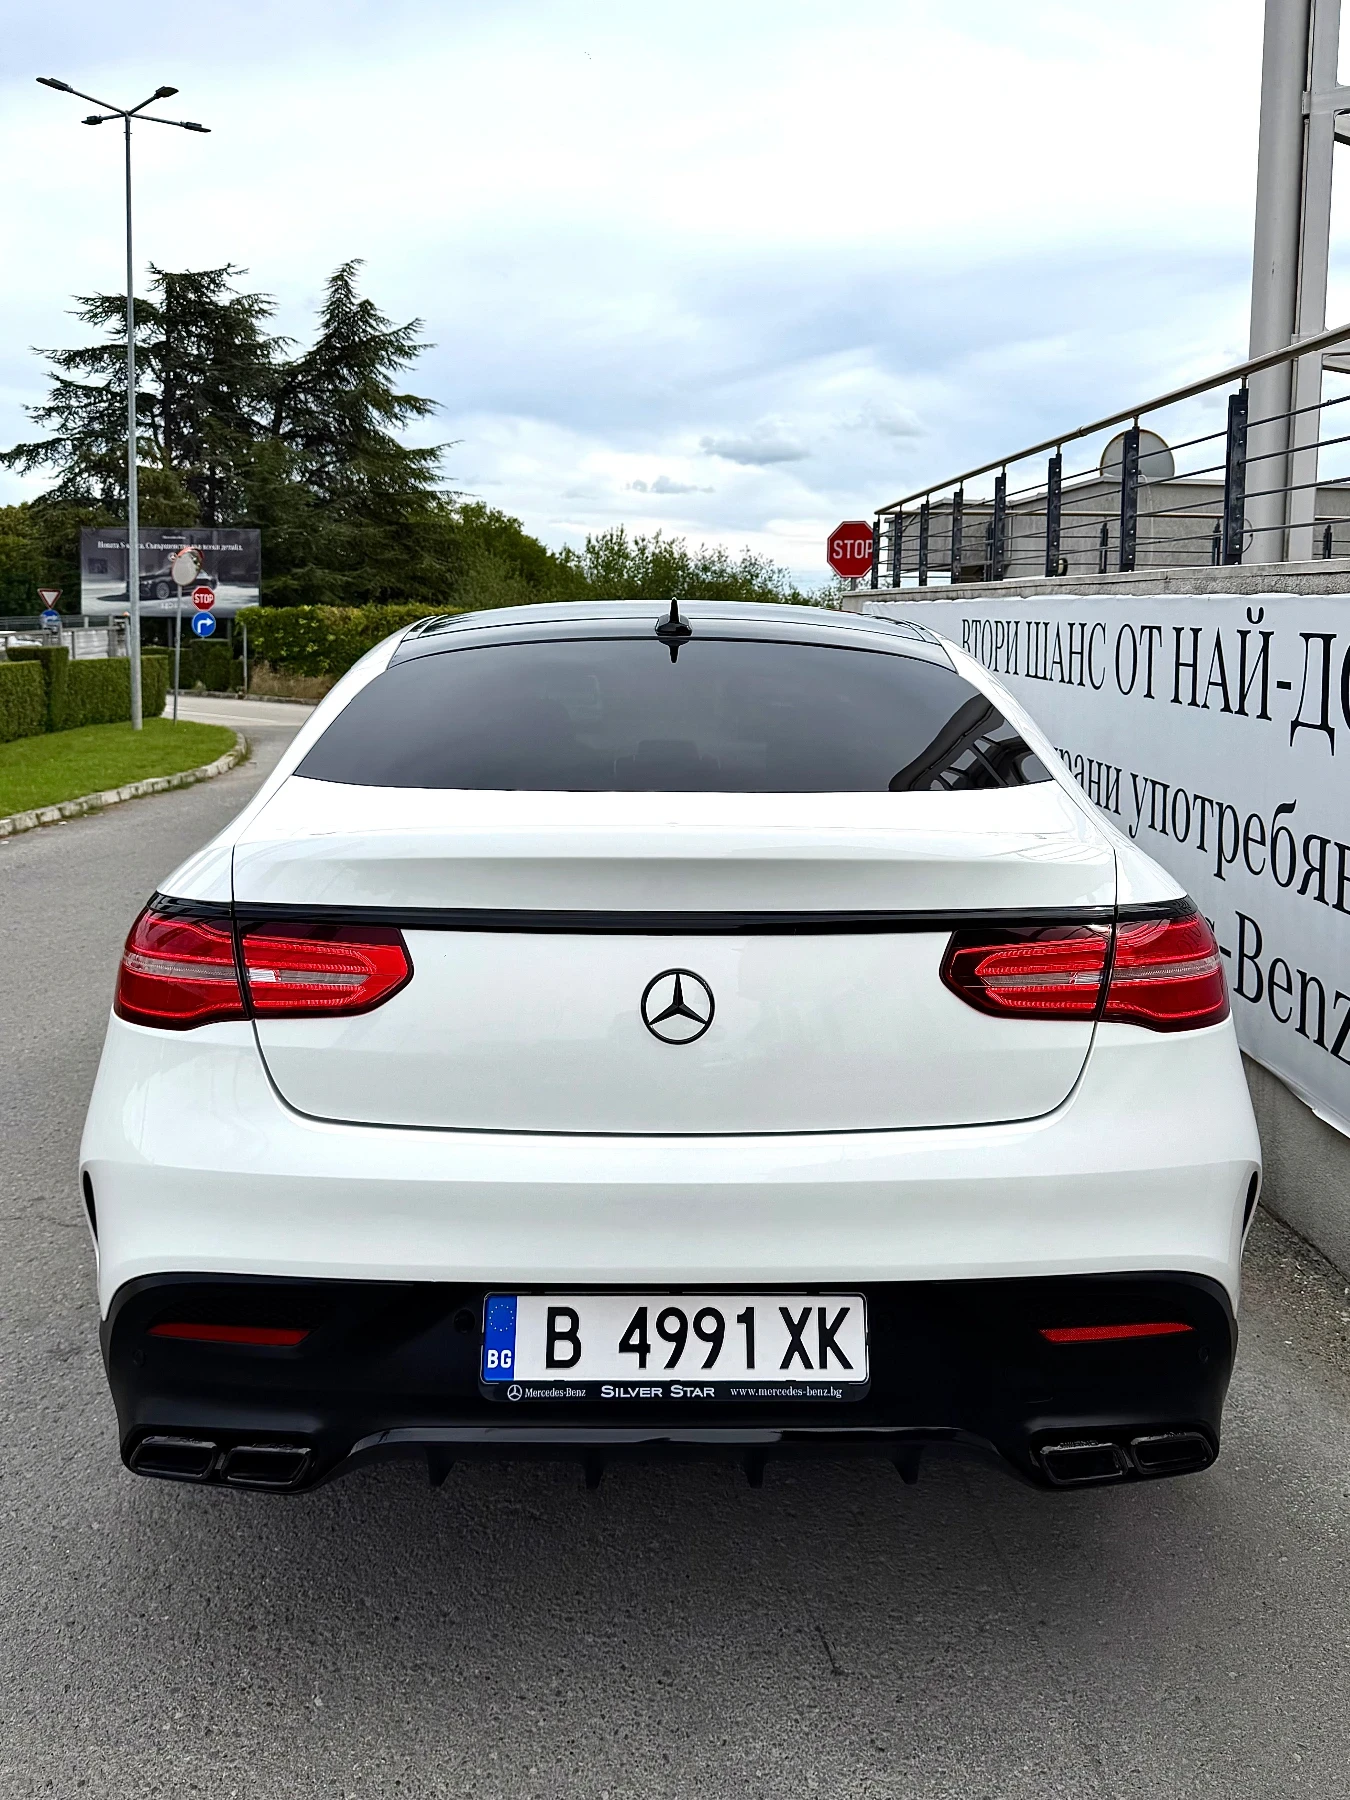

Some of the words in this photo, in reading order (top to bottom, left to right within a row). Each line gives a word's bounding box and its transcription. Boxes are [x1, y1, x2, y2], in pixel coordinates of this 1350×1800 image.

[833, 540, 873, 559] STOP
[194, 593, 213, 604] STOP
[962, 619, 1020, 676] ВТОРИ
[1025, 620, 1107, 690] ШАНС
[1115, 623, 1162, 699] ОТ
[1170, 606, 1350, 756] НАЙ-Д
[545, 1306, 582, 1370] B
[618, 1306, 755, 1370] 4991
[778, 1306, 855, 1370] XK
[487, 1349, 512, 1369] BG
[524, 1387, 586, 1398] Mercedes-Benz
[730, 1386, 842, 1399] www.mercedes-benz.bg
